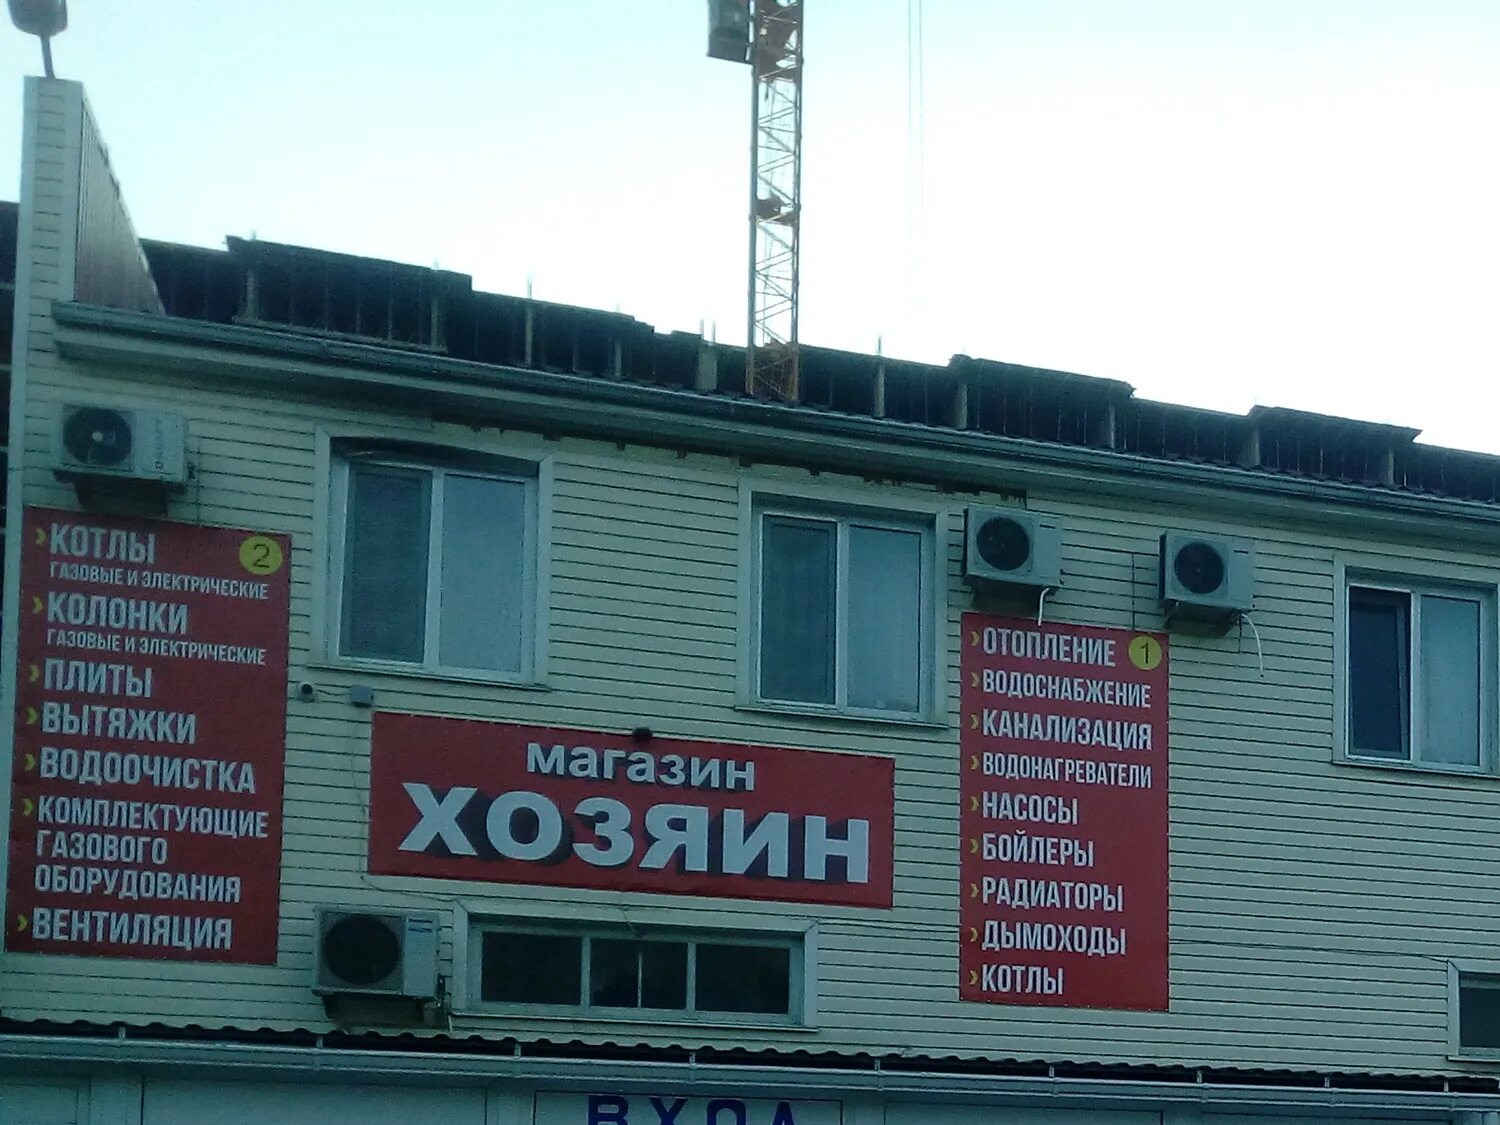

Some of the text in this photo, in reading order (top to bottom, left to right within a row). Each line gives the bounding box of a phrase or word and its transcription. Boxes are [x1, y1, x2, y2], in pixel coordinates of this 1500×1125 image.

[50, 523, 155, 564] КОТЛЫ
[252, 543, 271, 568] 2
[50, 562, 268, 600] ГАЗОВЫЕ И ЭЛЕКТРИЧЕСКИЕ
[47, 592, 188, 634] КОЛОНКИ
[47, 629, 266, 666] ГАЗОВЫЕ И ЭЛЕКТРИЧЕСКИЕ
[983, 626, 1116, 667] ОТОПЛЕНИЕ
[1140, 641, 1151, 664] 1
[44, 658, 152, 698] ПЛИТЫ
[982, 669, 1151, 708] ВОДОСНАБЖЕНИЕ
[42, 701, 196, 745] ВЫТЯЖКИ
[982, 708, 1152, 751] КАНАЛИЗАЦИЯ
[40, 747, 256, 794] ВОДООЧИСТКА
[982, 751, 1152, 789] ВОДОНАГРЕВАТЕЛИ
[37, 795, 269, 839] КОМПЛЕКТУЮЩИЕ
[982, 791, 1078, 825] НАСОСЫ
[36, 830, 168, 864] ГАЗОВОГО
[398, 781, 871, 884] ХОЗЯИН
[982, 829, 1094, 867] БОЙЛЕРЫ
[35, 865, 241, 903] ОБОРУДОВАНИЯ
[982, 876, 1123, 912] РАДИАТОРЫ
[32, 908, 233, 951] ВЕНТИЛЯЦИЯ
[981, 919, 1126, 956] ДЫМОХОДЫ
[981, 963, 1064, 995] КОТЛЫ
